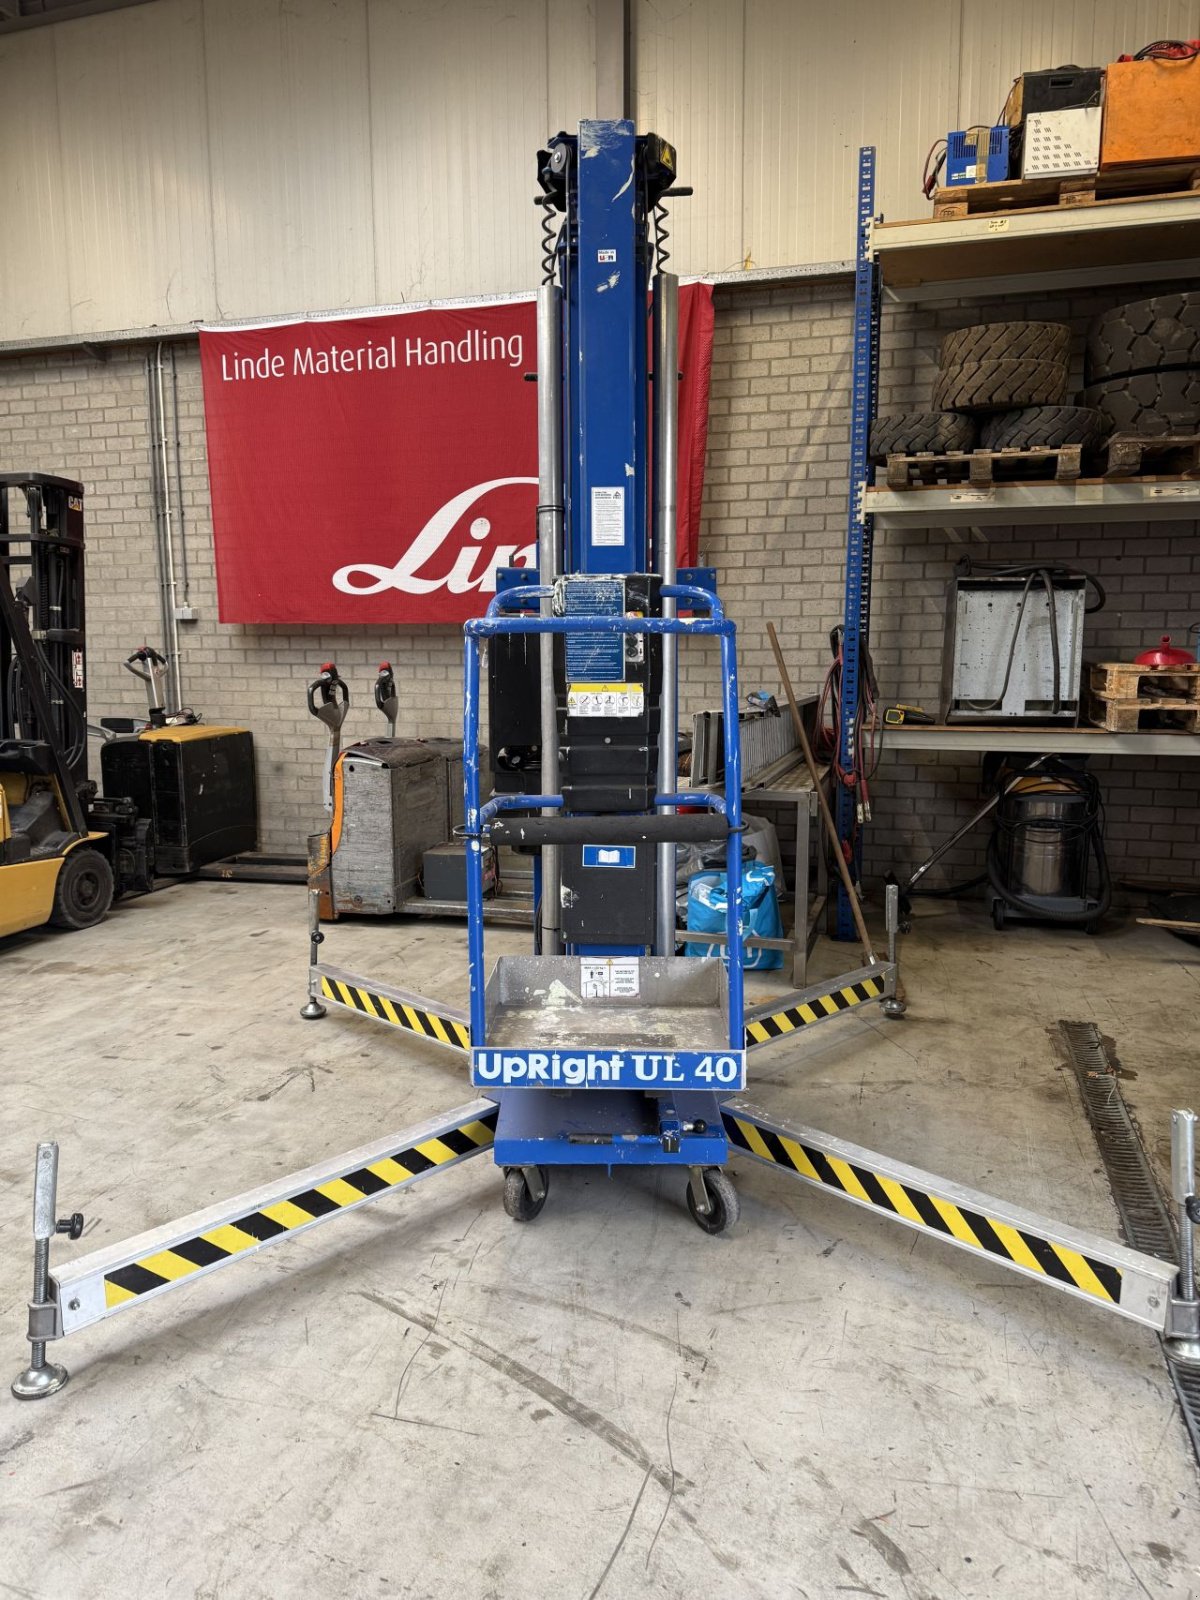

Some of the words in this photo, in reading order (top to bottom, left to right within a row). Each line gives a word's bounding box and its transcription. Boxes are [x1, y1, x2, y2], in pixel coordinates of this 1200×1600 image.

[222, 346, 285, 382] Linde
[293, 336, 396, 376] Material
[405, 329, 523, 368] Handling
[68, 496, 83, 512] CAT
[332, 476, 538, 595] Lin
[478, 1052, 625, 1085] UpRight
[631, 1054, 685, 1082] UL
[694, 1056, 738, 1083] 40
